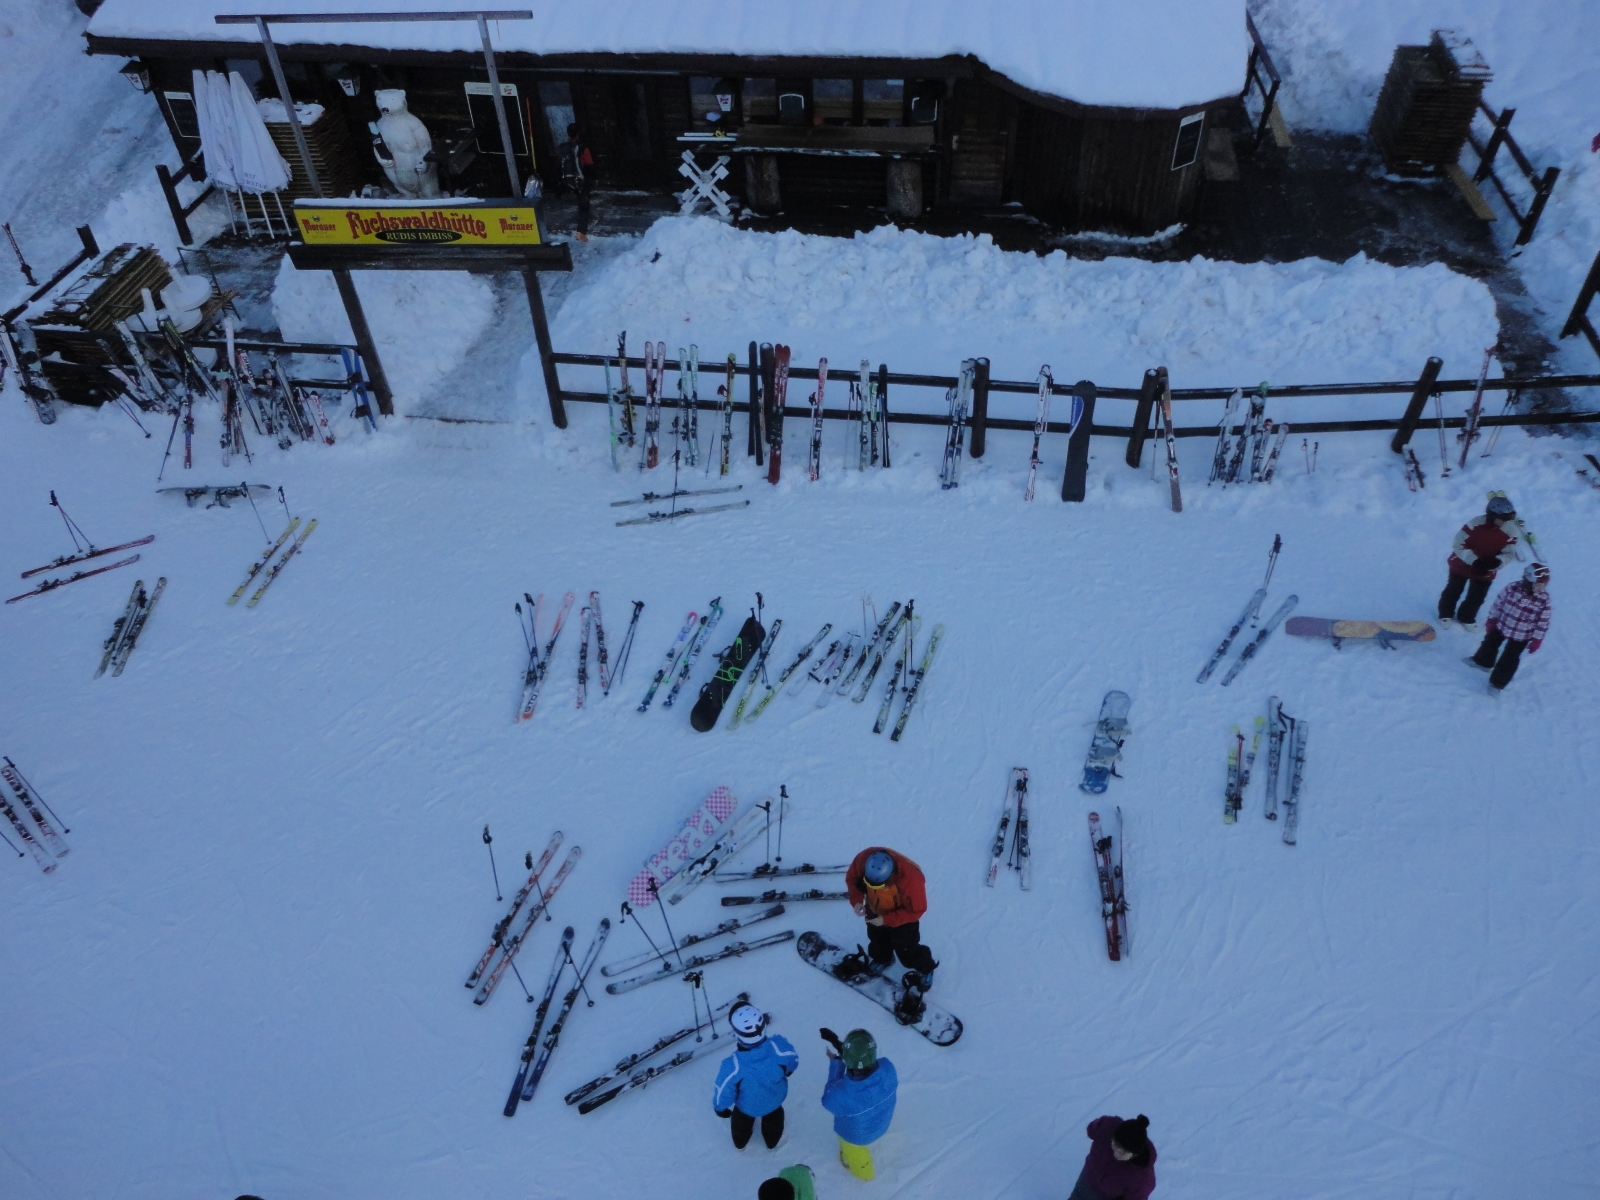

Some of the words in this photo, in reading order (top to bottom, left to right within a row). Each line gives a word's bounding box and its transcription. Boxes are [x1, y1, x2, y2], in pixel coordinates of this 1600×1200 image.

[345, 211, 488, 240] Fuchswaldhütte
[386, 232, 416, 240] RUDIS
[418, 232, 453, 240] IMBISS
[498, 218, 534, 234] Murauer
[646, 806, 722, 884] head
